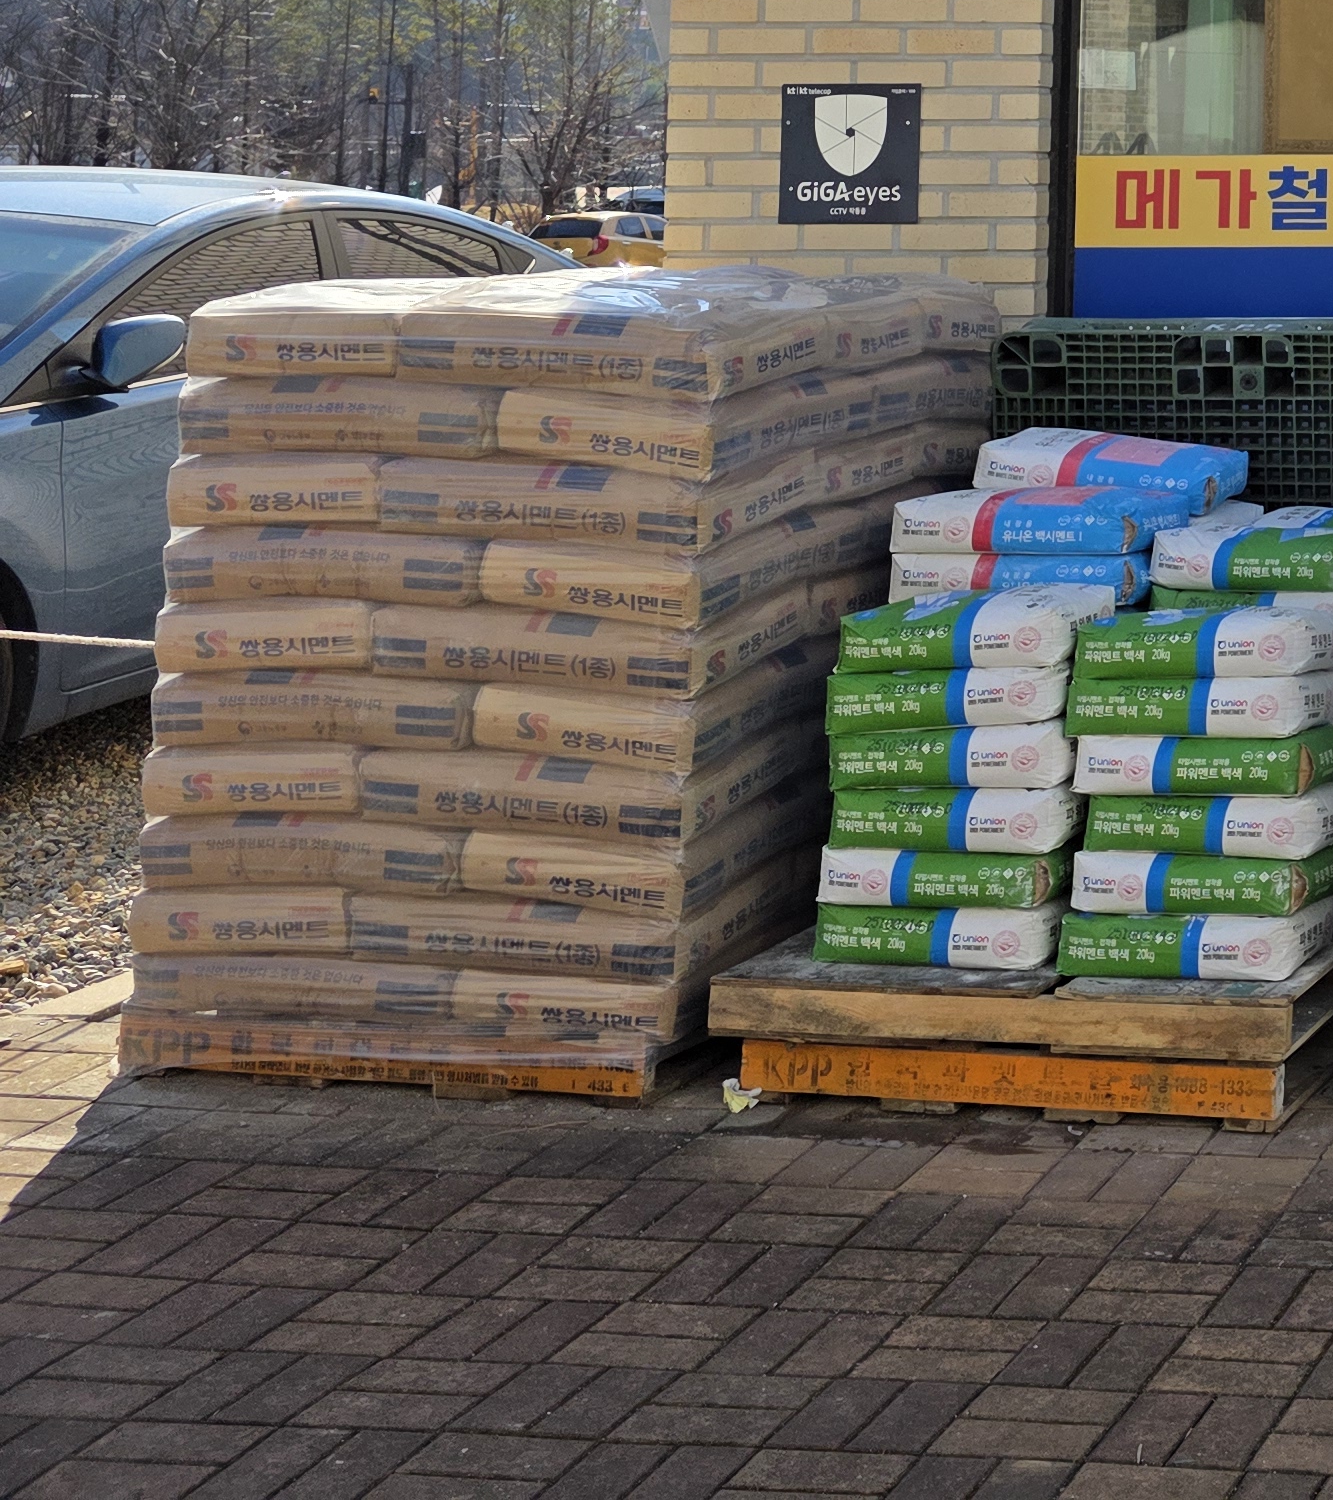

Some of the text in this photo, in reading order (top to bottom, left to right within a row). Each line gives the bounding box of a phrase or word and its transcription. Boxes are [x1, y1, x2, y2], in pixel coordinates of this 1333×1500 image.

[797, 182, 901, 205] GiGAeyes
[589, 432, 701, 468] 쌍용시멘트
[913, 519, 941, 529] union
[1035, 531, 1075, 542] 백시멘트
[567, 585, 684, 618] 쌍용시멘트
[978, 687, 1004, 696] union
[833, 701, 920, 717] 파워멘트 백색 20kg
[561, 728, 678, 762] 쌍용시멘트
[1097, 757, 1123, 767] union
[1176, 766, 1268, 780] 파워멘트 백색 20kg
[836, 871, 861, 881] union
[549, 875, 667, 909] 쌍용시멘트
[913, 883, 1004, 898] 파워멘트 백색 20kg
[1108, 948, 1130, 961] 백색
[1136, 949, 1155, 963] 20kg
[1212, 944, 1240, 953] union
